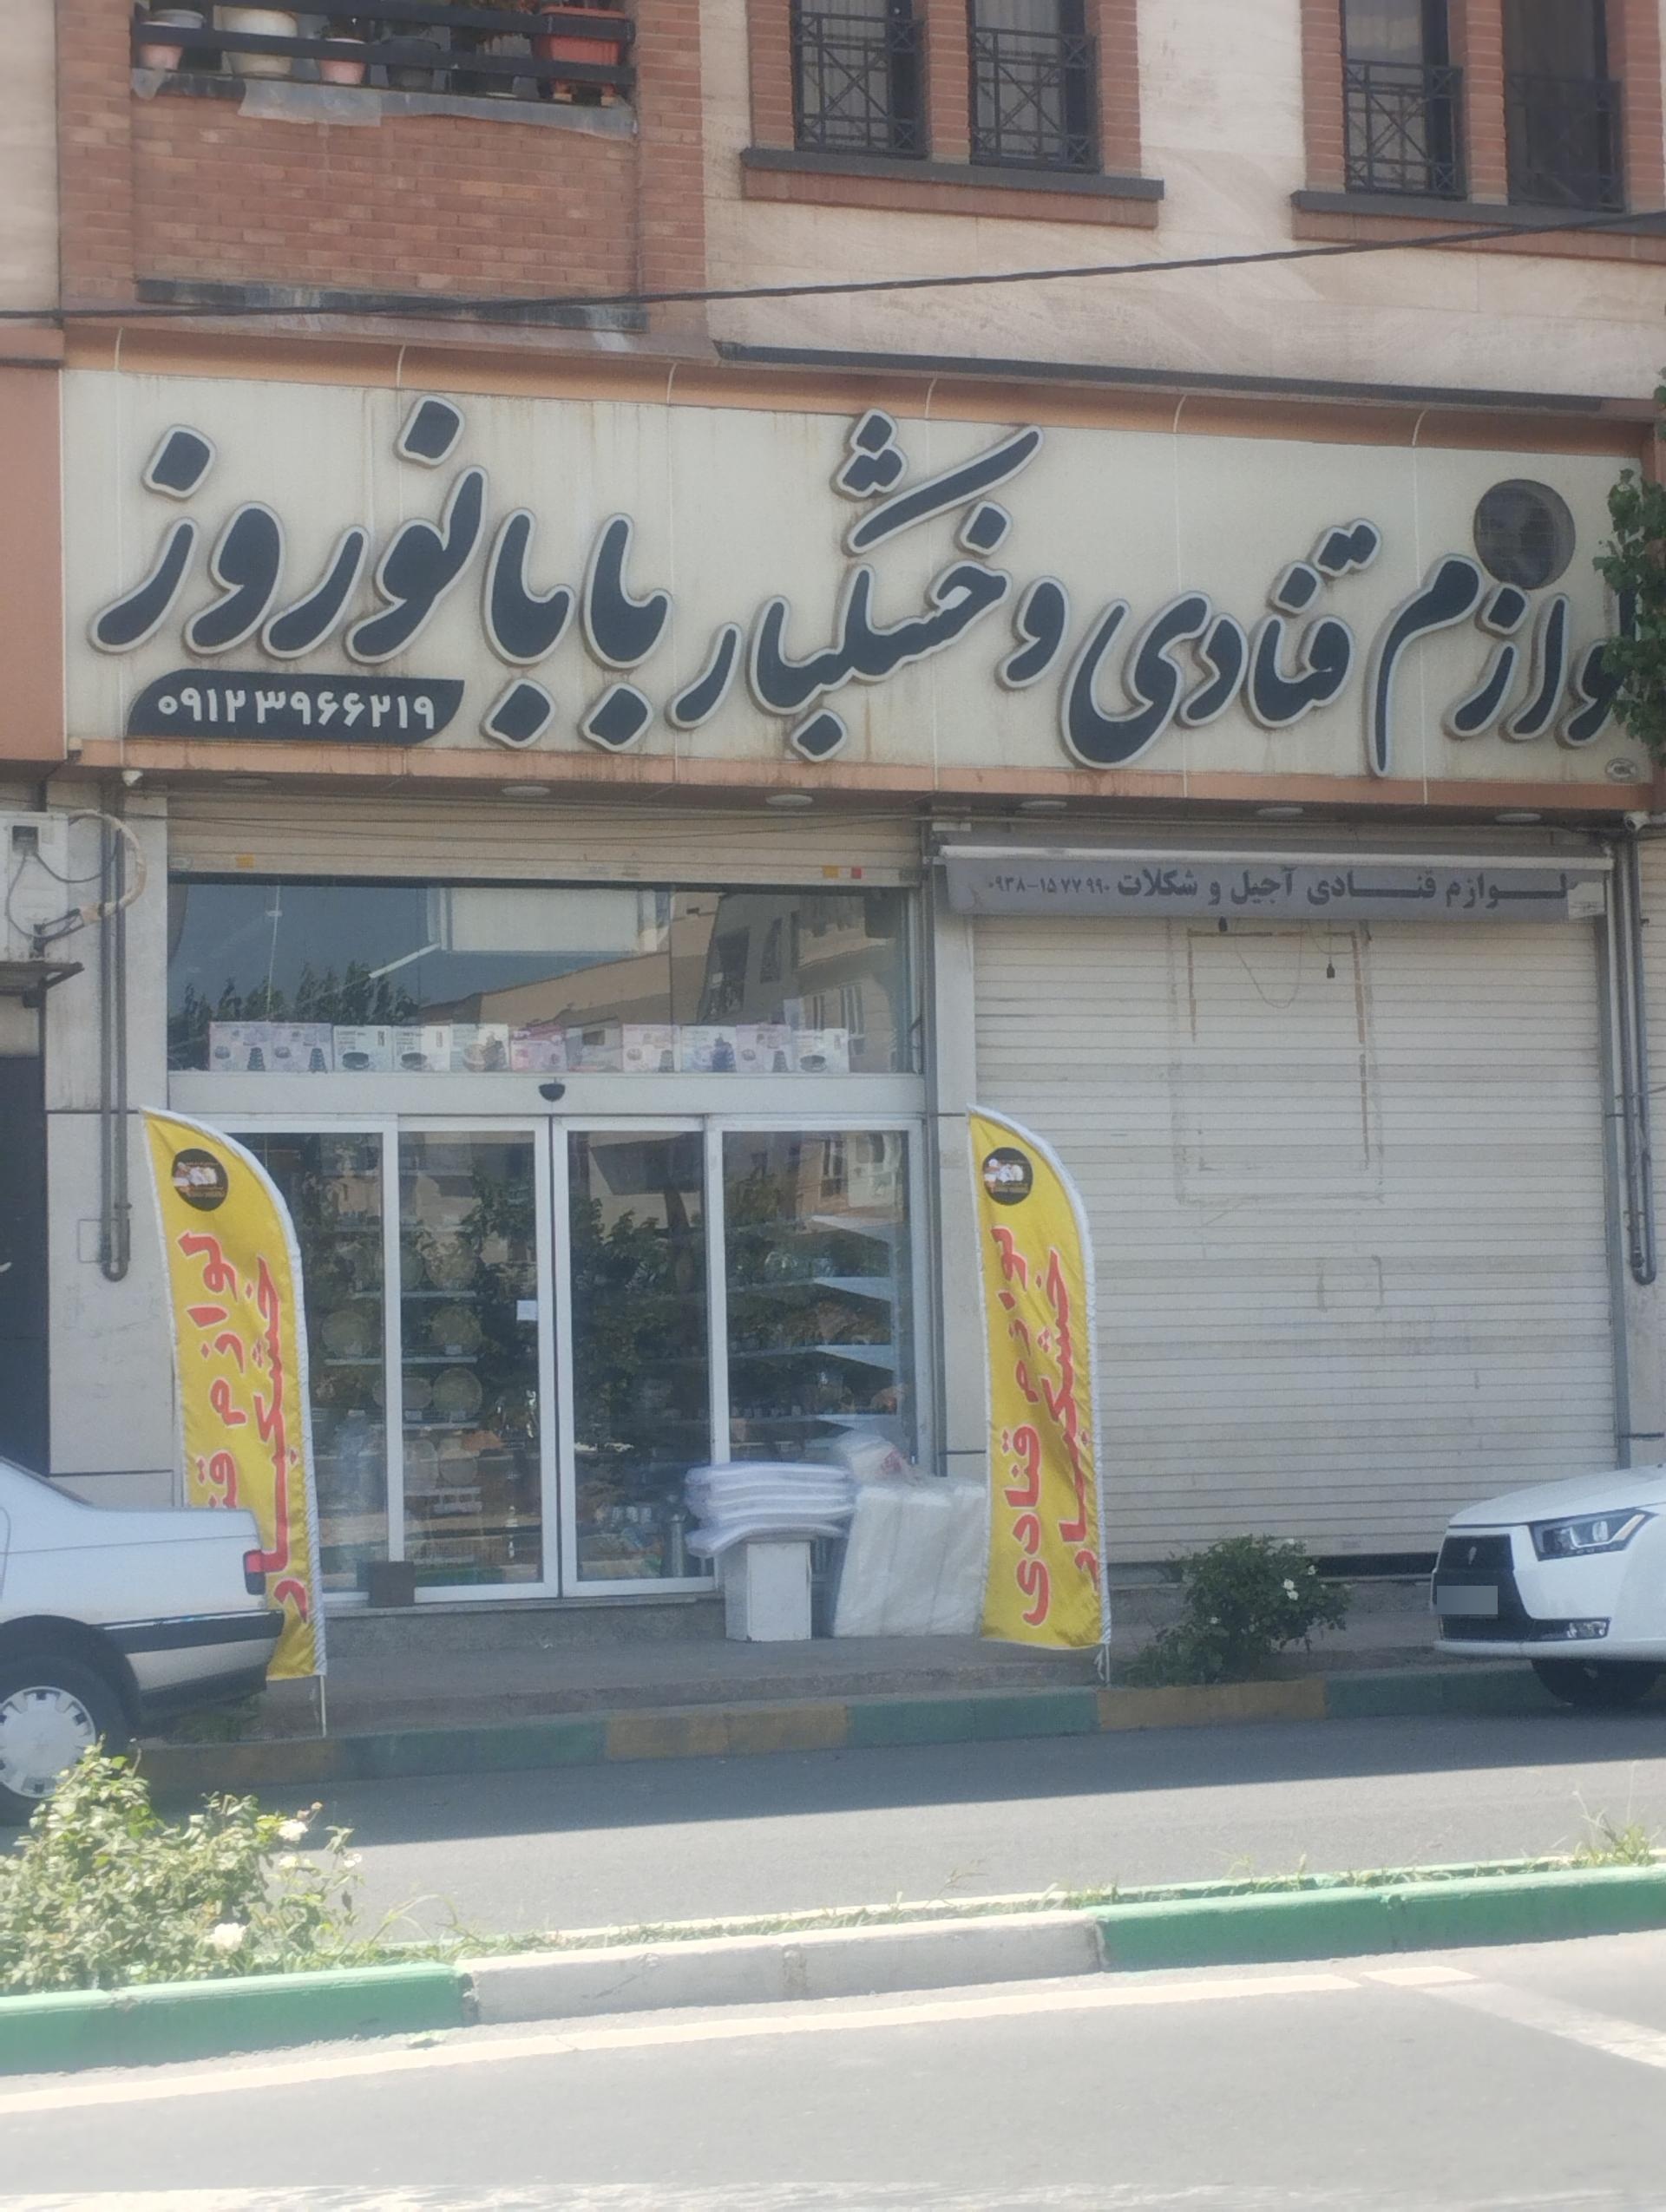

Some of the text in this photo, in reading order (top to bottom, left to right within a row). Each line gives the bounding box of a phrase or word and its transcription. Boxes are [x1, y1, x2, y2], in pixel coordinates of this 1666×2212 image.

[90, 395, 489, 664] نوروز
[667, 409, 1042, 762] خشکبار
[158, 687, 435, 730] ۰۹۱۲۳۹۶۶۲۱۹
[480, 508, 672, 751] بابا
[997, 576, 1069, 689] و
[1062, 518, 1381, 770] قنادی
[1117, 867, 1197, 898] شکلات
[1207, 879, 1222, 906] و
[1230, 867, 1295, 906] آجیل
[1307, 868, 1437, 906] قنادی
[1445, 871, 1567, 909] لوازم
[176, 1231, 248, 1427] لوازم
[990, 1225, 1040, 1404] لوازم
[245, 1255, 308, 1623] خشکبار
[1036, 1247, 1101, 1595] خشکبار
[1001, 1423, 1051, 1626] قنادی
